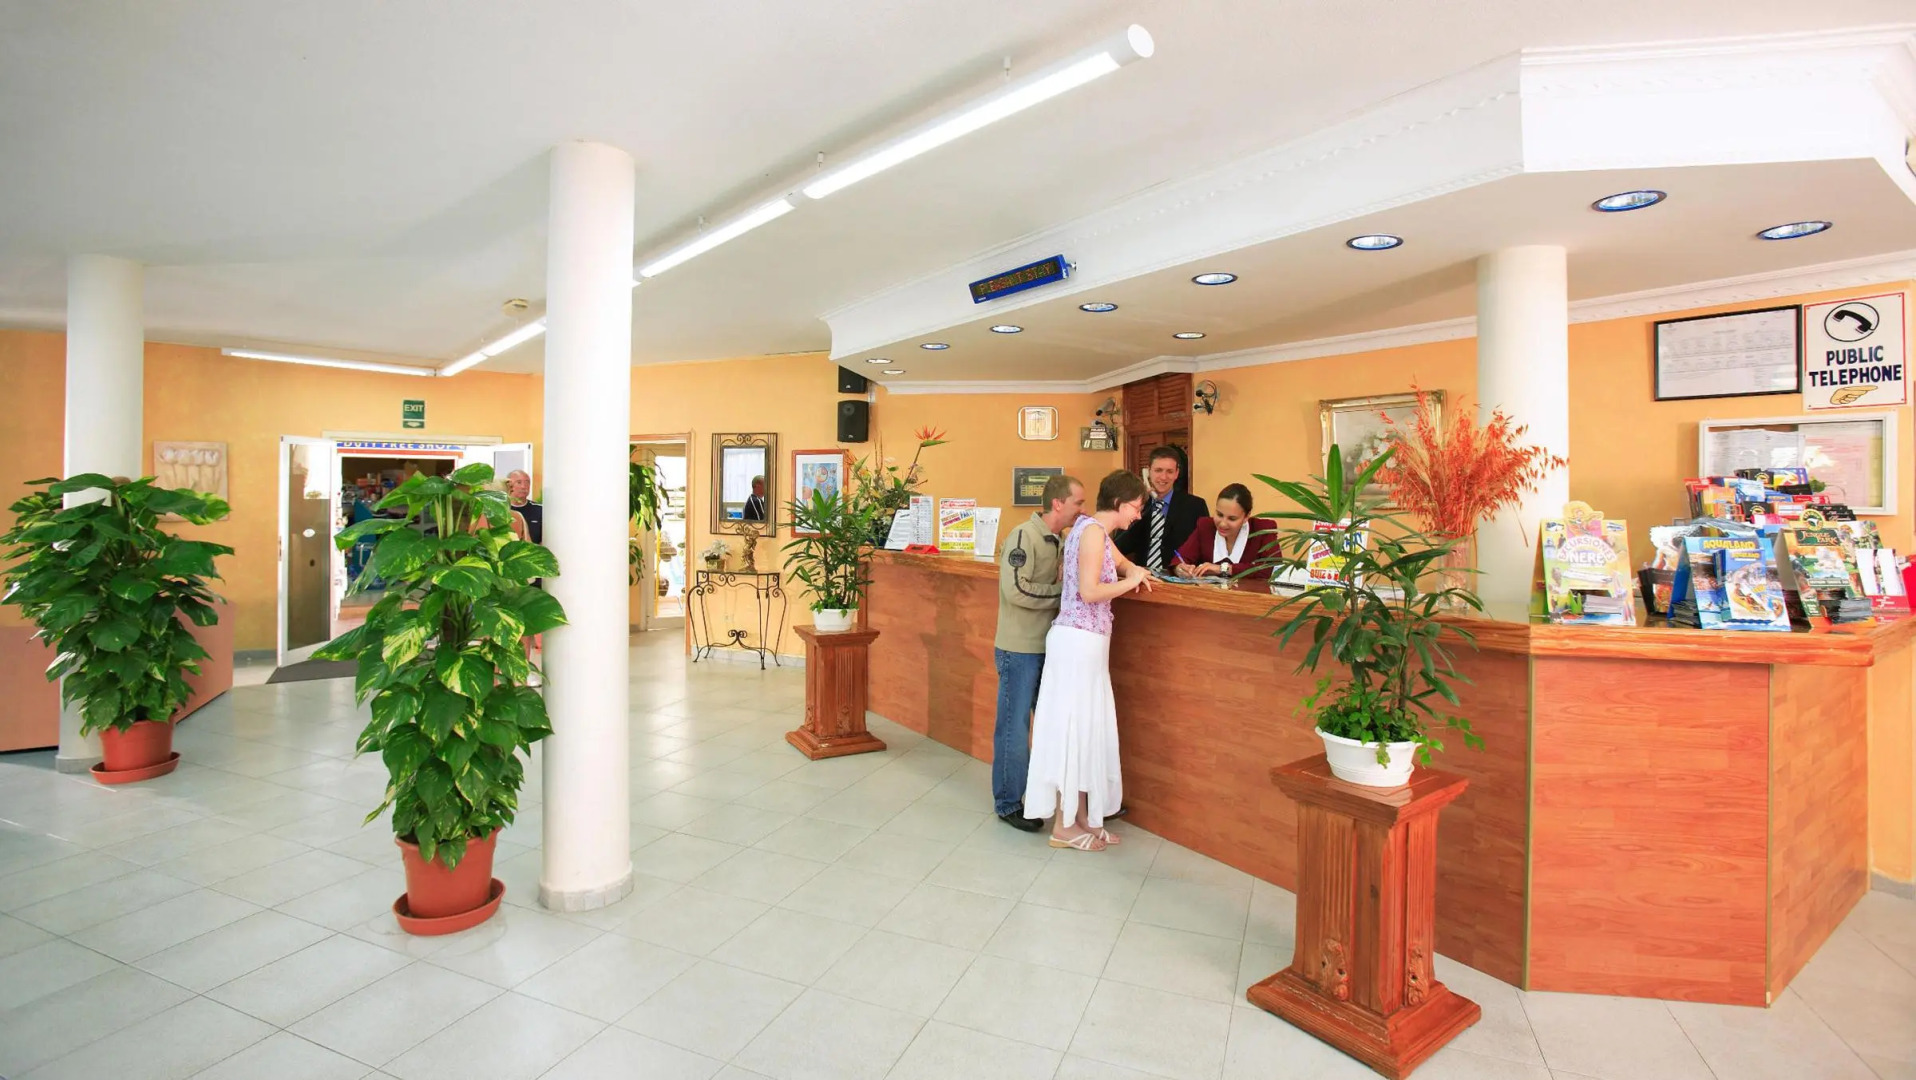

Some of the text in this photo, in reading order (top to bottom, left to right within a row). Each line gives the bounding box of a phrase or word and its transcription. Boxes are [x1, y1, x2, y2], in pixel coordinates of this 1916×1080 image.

[1826, 345, 1884, 366] PUBLIC
[1808, 364, 1902, 387] TELEPHONE
[404, 404, 424, 412] EXIT
[1703, 540, 1756, 550] AQUALAND
